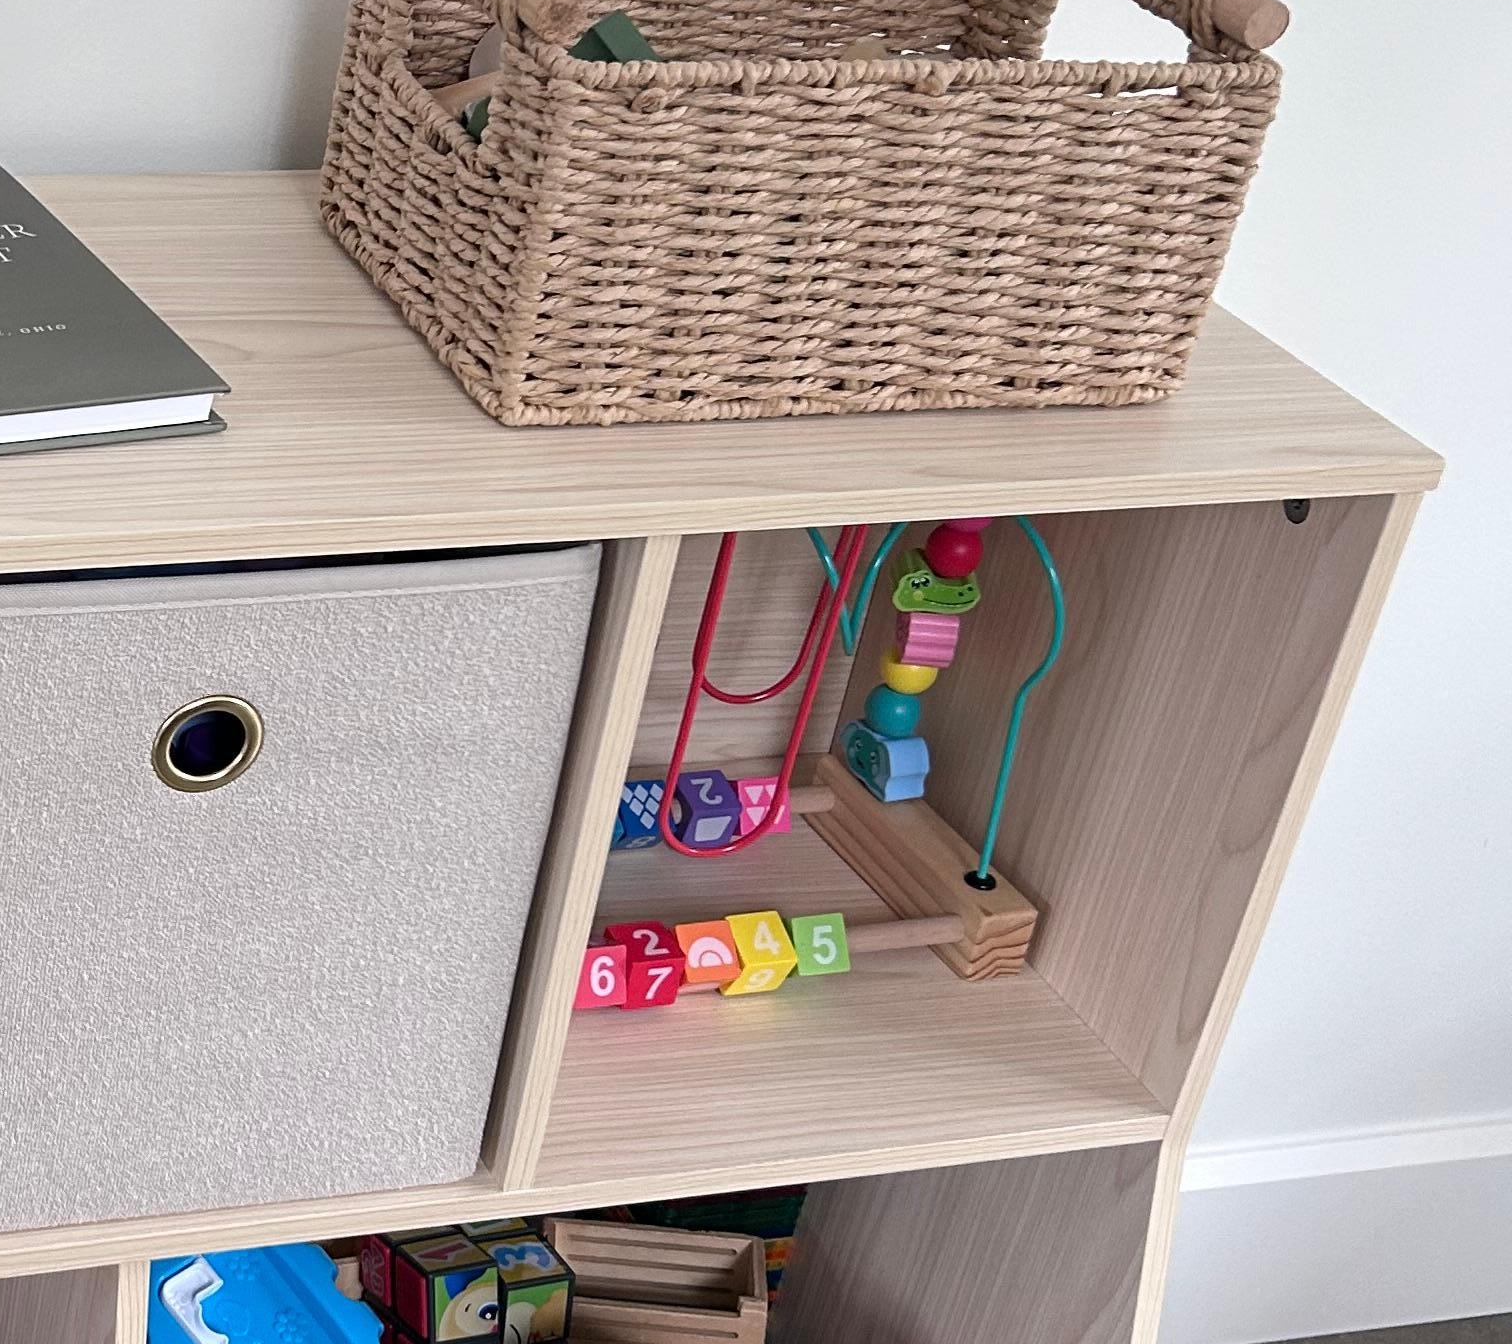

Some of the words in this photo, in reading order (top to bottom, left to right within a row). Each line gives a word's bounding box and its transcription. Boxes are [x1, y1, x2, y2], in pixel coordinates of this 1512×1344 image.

[19, 323, 67, 335] OHIO
[690, 777, 723, 805] 2
[632, 929, 669, 956] 2
[754, 921, 781, 955] 4
[812, 925, 837, 965] 5
[590, 956, 615, 997] 6
[645, 966, 673, 1000] 7
[490, 1241, 554, 1270] 3
